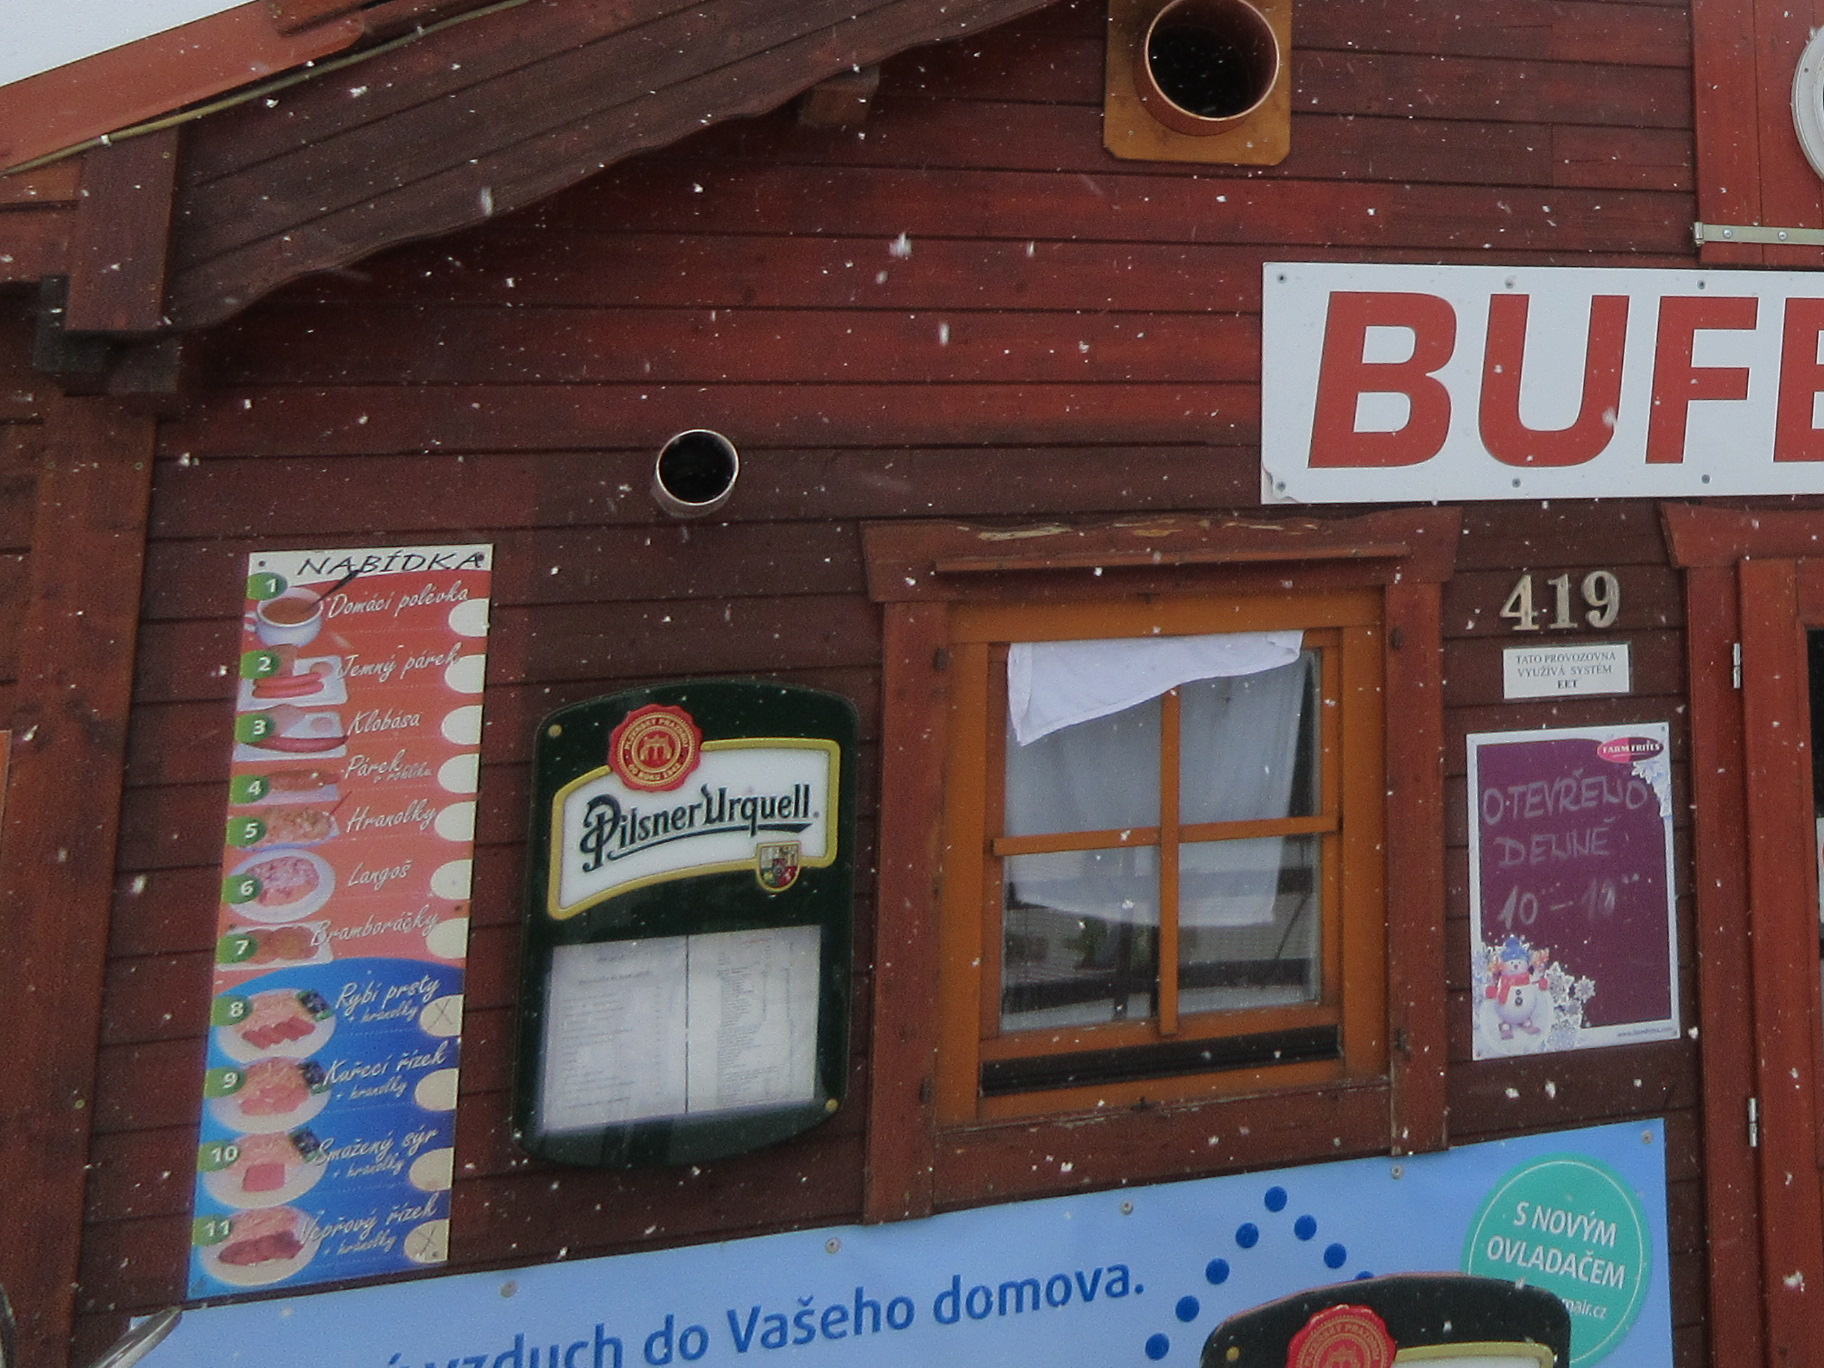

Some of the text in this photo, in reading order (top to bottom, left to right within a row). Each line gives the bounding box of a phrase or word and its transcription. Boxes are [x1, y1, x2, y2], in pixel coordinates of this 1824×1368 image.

[297, 549, 485, 576] NABÍDKA
[266, 577, 469, 619] 1 Domácí polévka
[1500, 571, 1620, 630] 419
[258, 642, 460, 681] 2 Jemný párek
[1516, 651, 1616, 664] TATO PROVOZOVNA
[1517, 663, 1612, 678] VYUŽÍVÁ SYSTÉM
[1557, 680, 1578, 689] EET
[253, 713, 420, 735] 3 Klobása
[1631, 740, 1660, 752] FRITES
[248, 749, 401, 795] 4 Párek
[1482, 768, 1648, 826] OTEVŘENO
[245, 807, 436, 838] 5 Hranolky
[579, 783, 810, 873] Pilsner Urquell
[240, 859, 410, 895] 6 Langoš
[235, 904, 439, 955] 7 Bramboráčky
[230, 975, 440, 1017] 8 Rybí prsty
[223, 1072, 237, 1088] 9
[396, 1040, 448, 1072] řízek
[211, 1127, 439, 1165] 10 Smažený sýr
[206, 1192, 440, 1243] 11 Vepřový řízek
[1512, 1201, 1617, 1248] S NOVÝM
[1486, 1235, 1626, 1290] OVLADAČEM
[424, 1263, 1145, 1368] duch do Vašeho domova.
